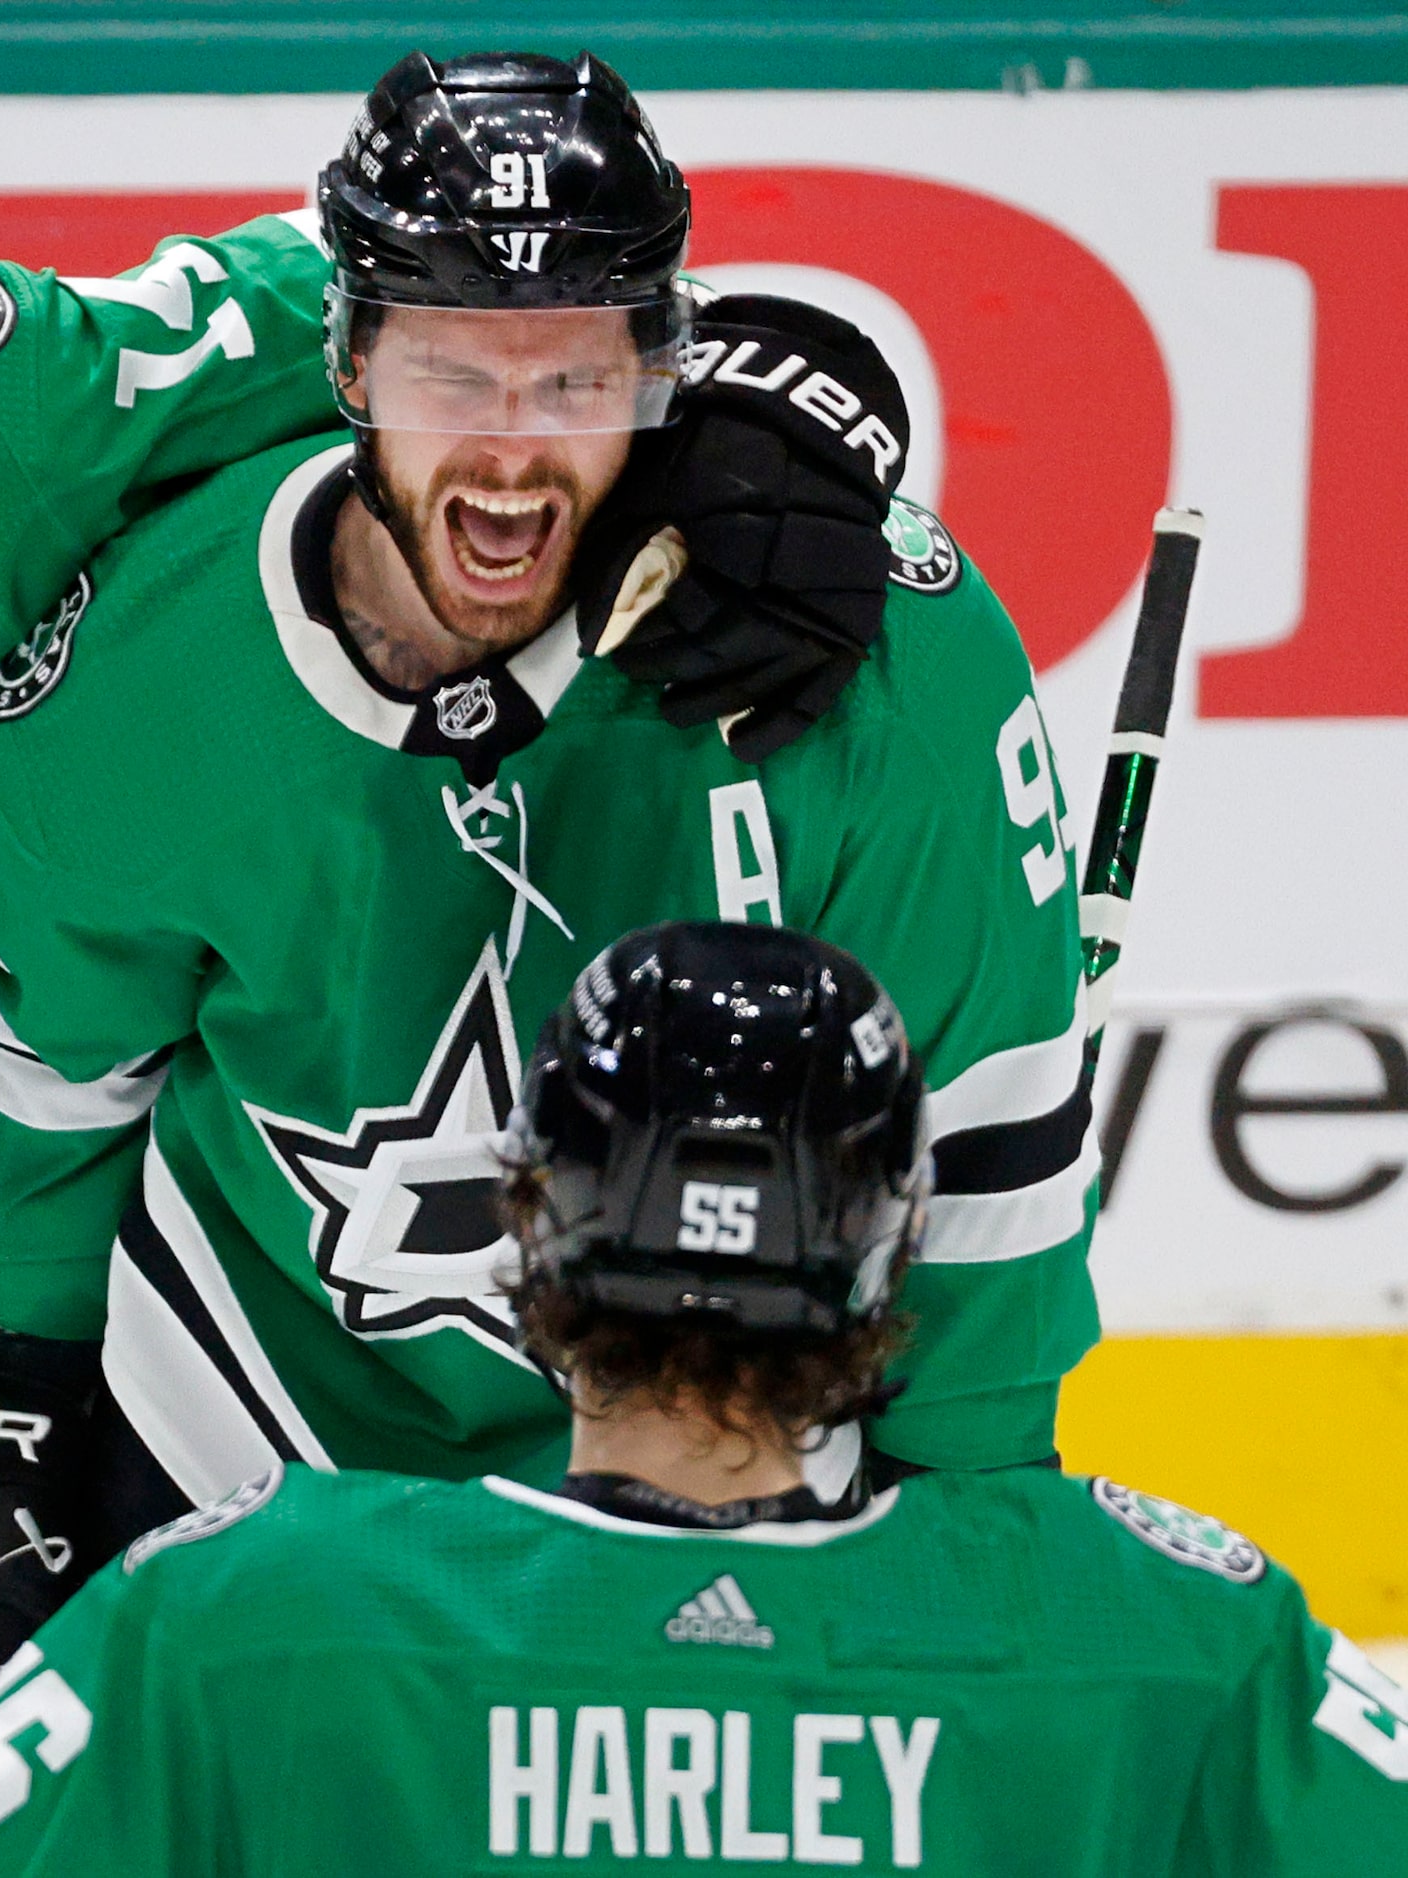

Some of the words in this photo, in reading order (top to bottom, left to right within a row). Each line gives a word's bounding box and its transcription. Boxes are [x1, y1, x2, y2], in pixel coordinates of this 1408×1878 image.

[490, 151, 551, 209] 91
[677, 339, 902, 485] AUER
[709, 779, 784, 928] A
[676, 1181, 761, 1255] 55
[664, 1617, 776, 1650] adidas
[488, 1705, 941, 1868] HARLEY
